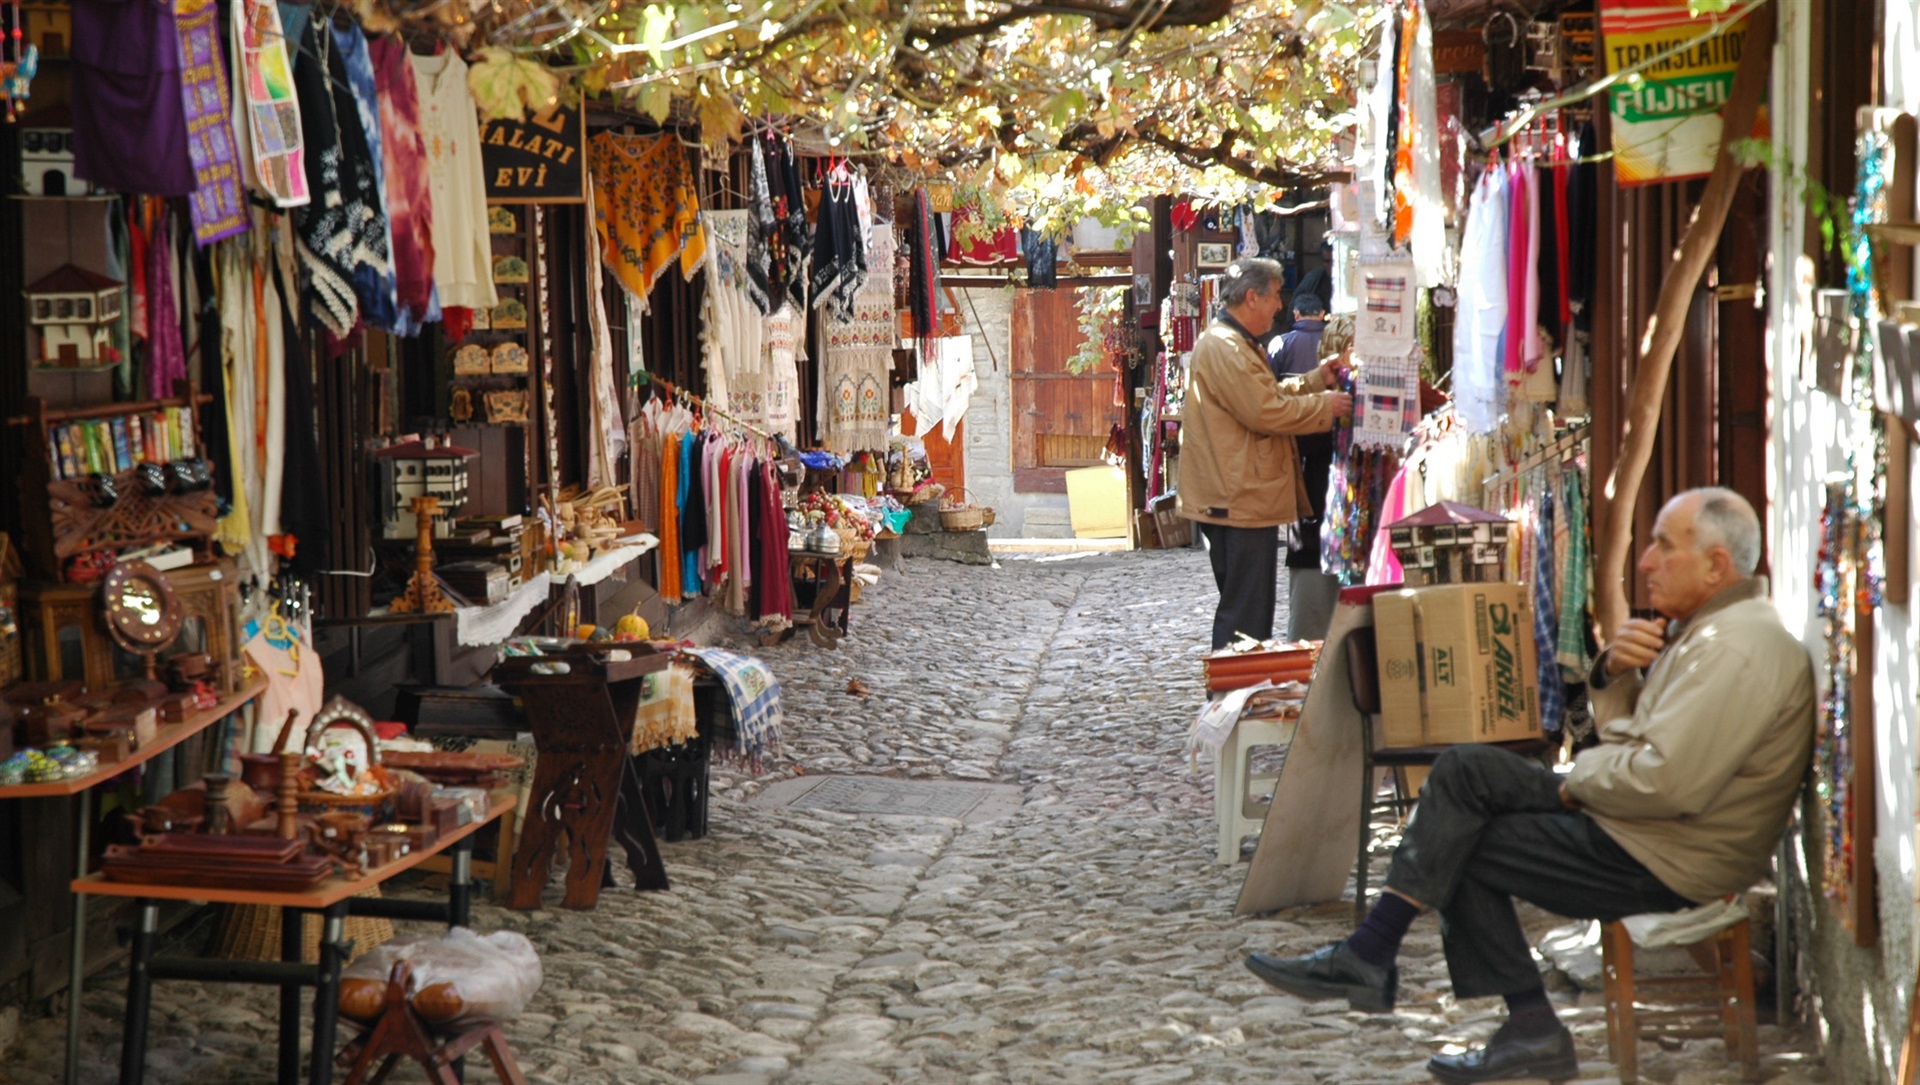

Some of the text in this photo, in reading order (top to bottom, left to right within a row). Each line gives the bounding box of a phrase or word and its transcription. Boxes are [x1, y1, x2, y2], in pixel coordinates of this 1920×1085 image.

[1613, 32, 1746, 73] TRANSLATIO
[1615, 80, 1727, 117] FUJIFIL
[494, 162, 547, 187] EVİ
[1437, 648, 1450, 684] ALT
